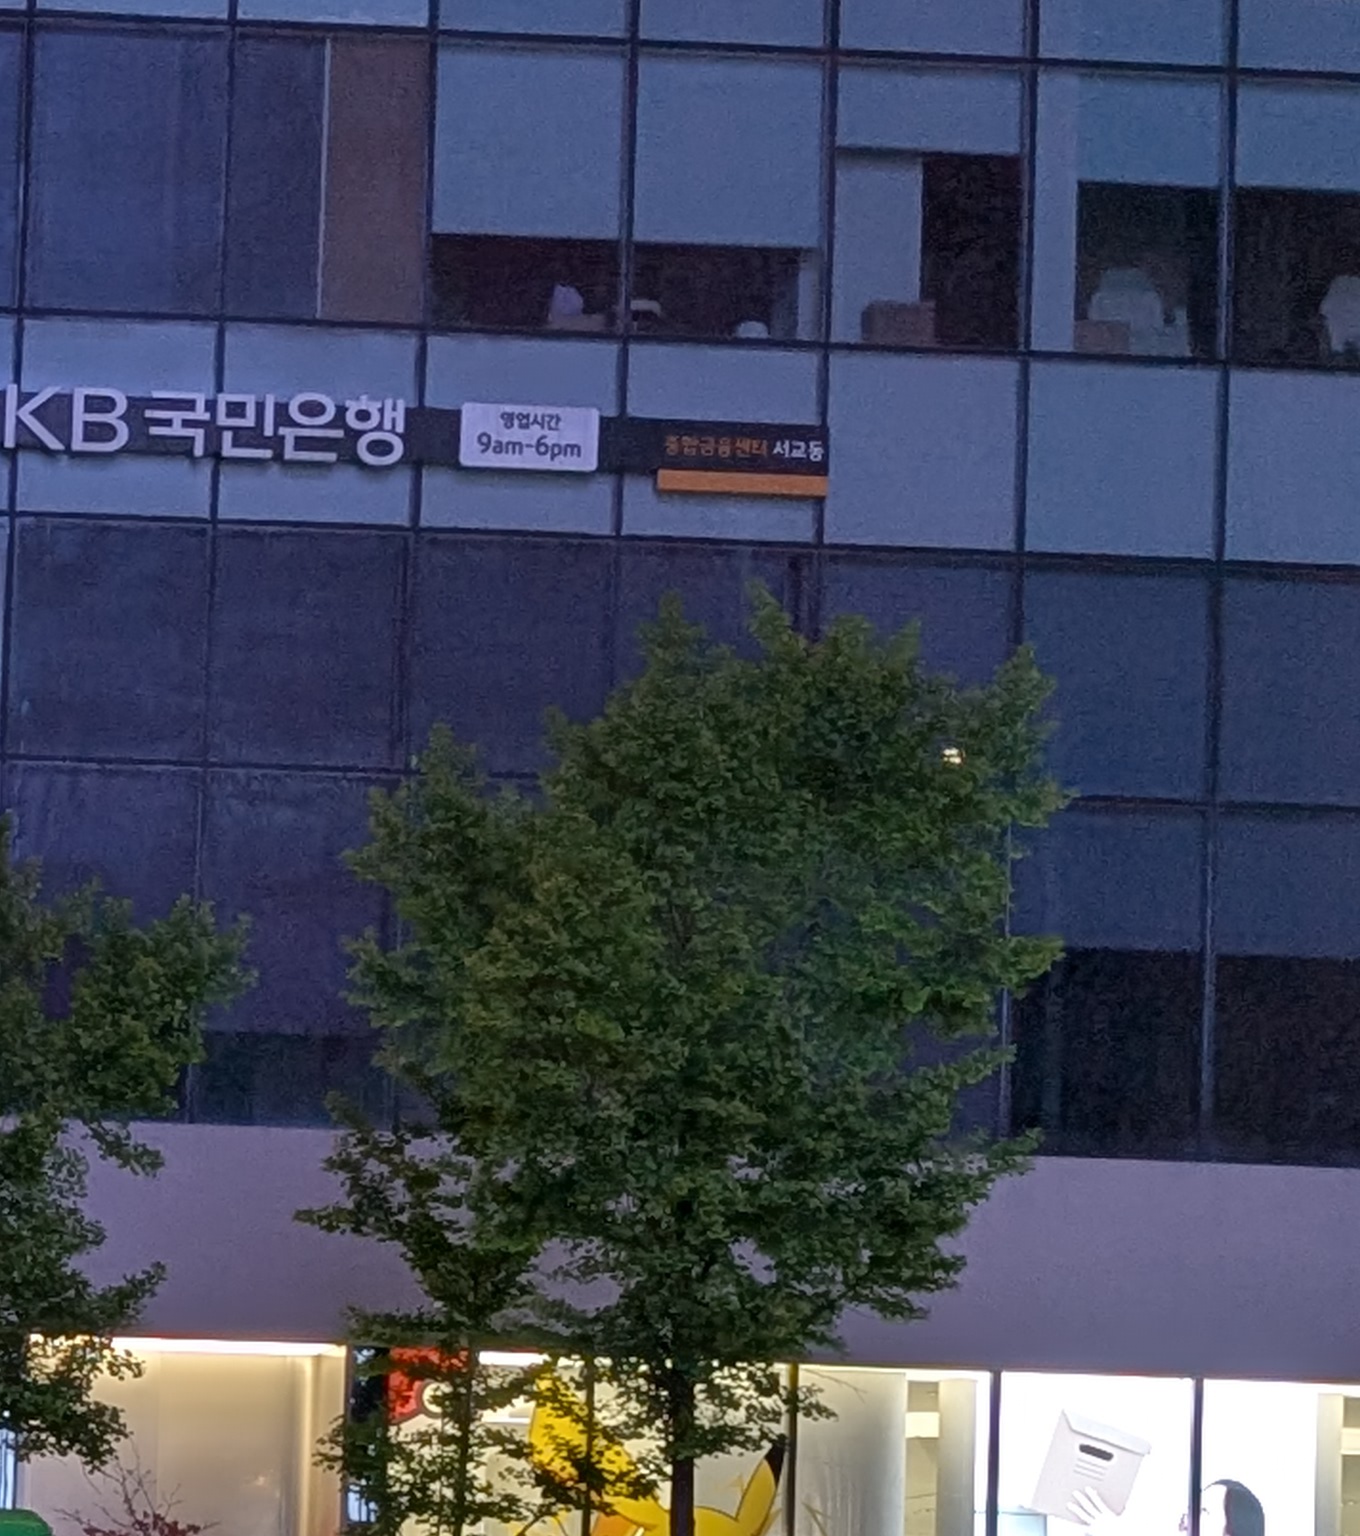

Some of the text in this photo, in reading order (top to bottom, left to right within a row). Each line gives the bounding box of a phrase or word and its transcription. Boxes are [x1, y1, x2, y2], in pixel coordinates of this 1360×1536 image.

[499, 411, 562, 431] 영업시간
[476, 431, 582, 462] 9am-6pm
[772, 441, 824, 462] 서교동
